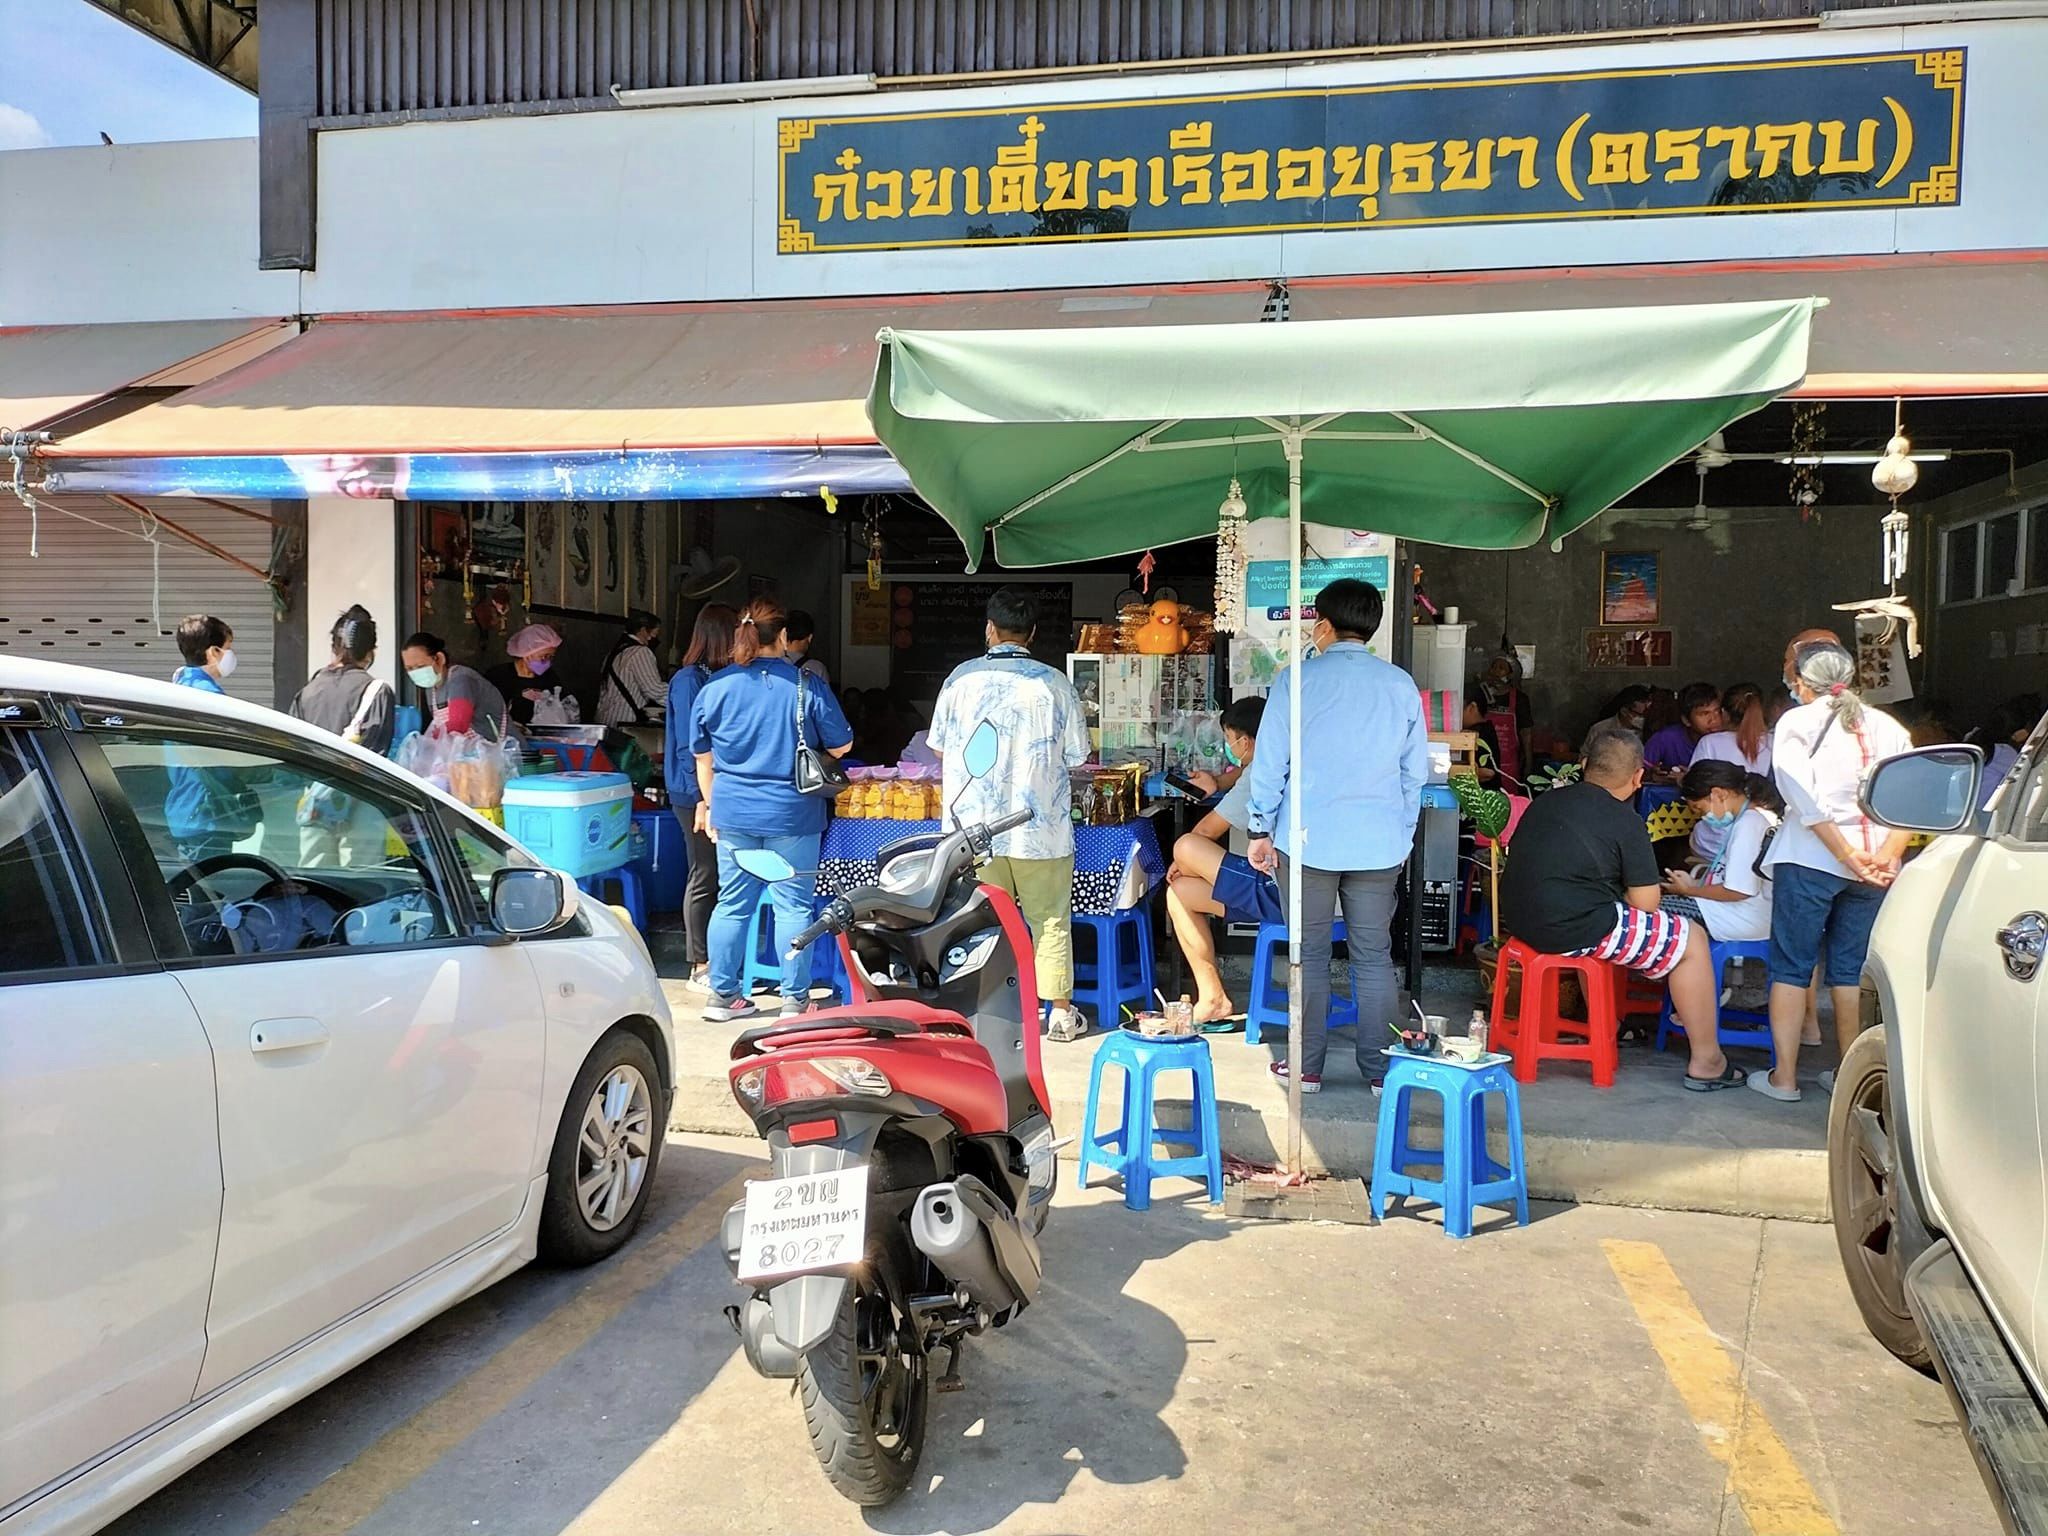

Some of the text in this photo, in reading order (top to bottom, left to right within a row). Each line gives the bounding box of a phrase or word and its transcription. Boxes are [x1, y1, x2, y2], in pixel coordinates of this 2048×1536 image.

[813, 96, 1914, 222] ก๋วยเตี๋ยวเรืออยุธยา (ตรากบ)
[750, 1208, 860, 1239] กรุงเทพมหานคร
[758, 1233, 845, 1270] 8027
